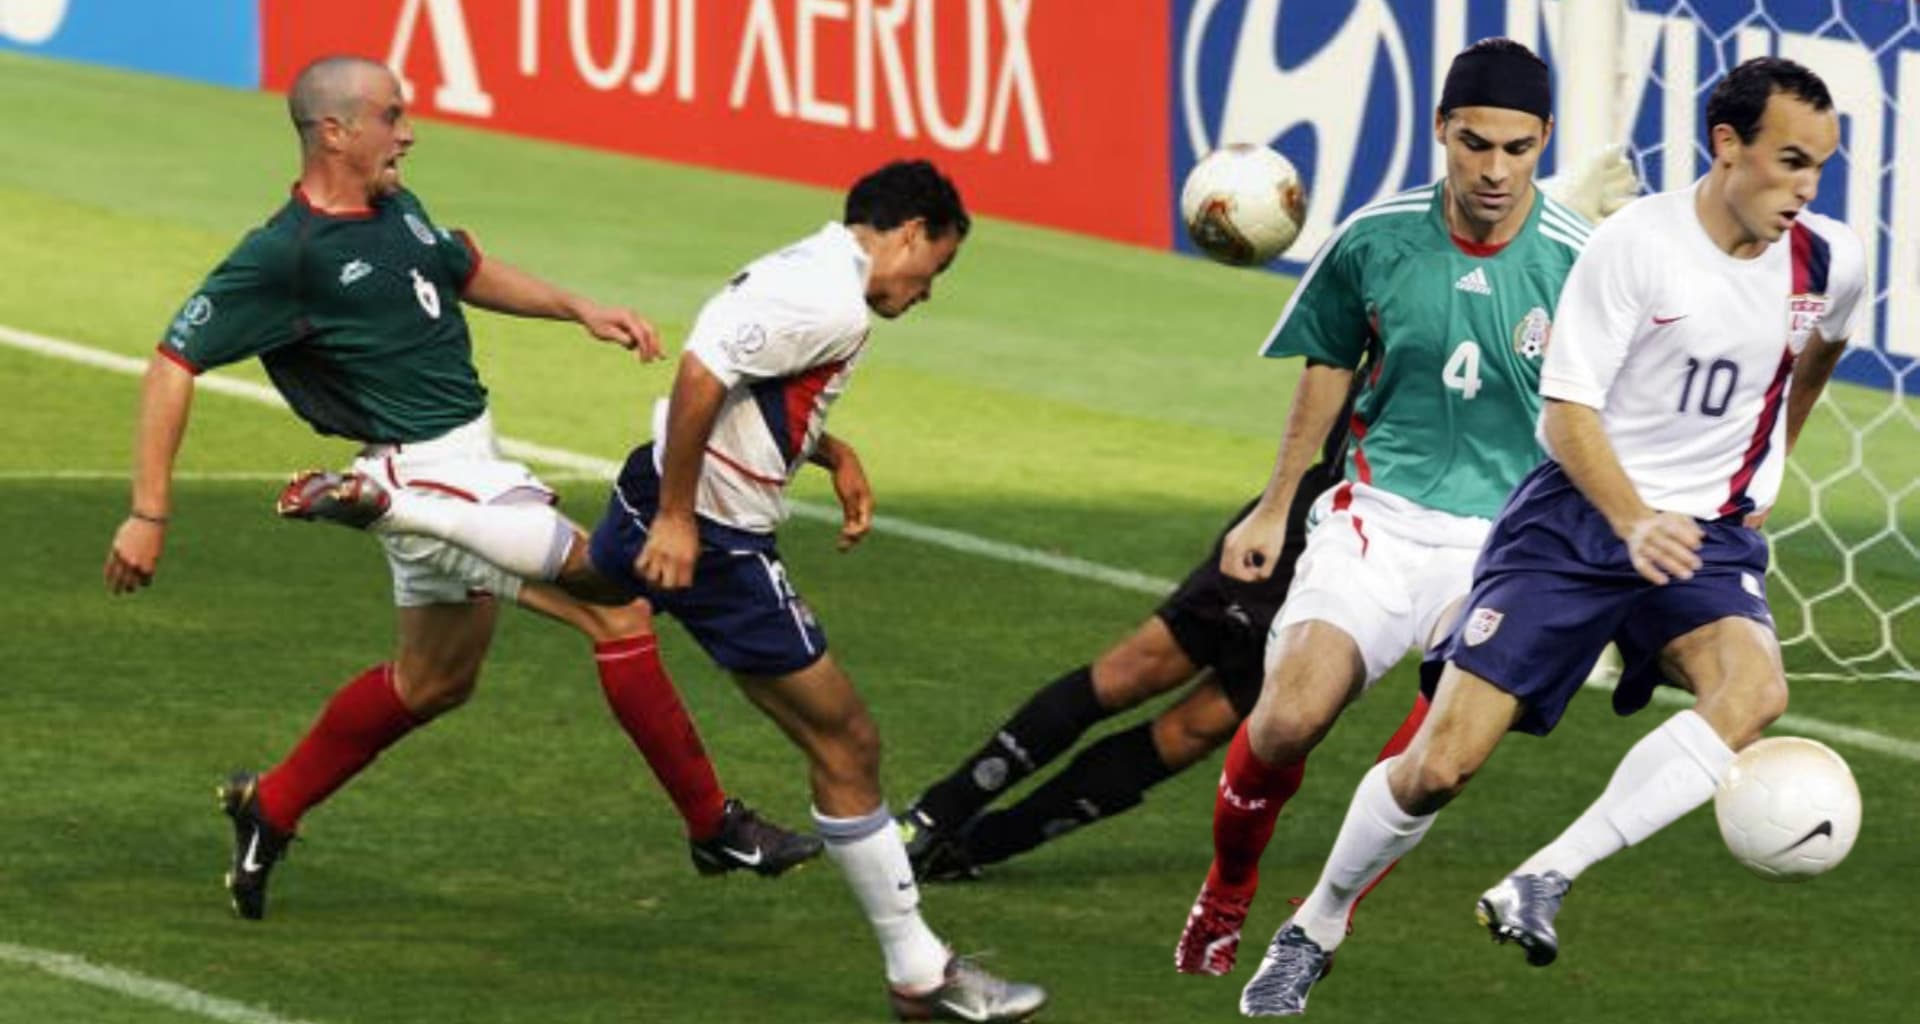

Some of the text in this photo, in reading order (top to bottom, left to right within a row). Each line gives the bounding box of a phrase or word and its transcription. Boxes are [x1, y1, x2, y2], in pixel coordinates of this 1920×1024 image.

[409, 268, 441, 319] 6
[1442, 340, 1483, 400] 4
[1677, 357, 1739, 417] 10
